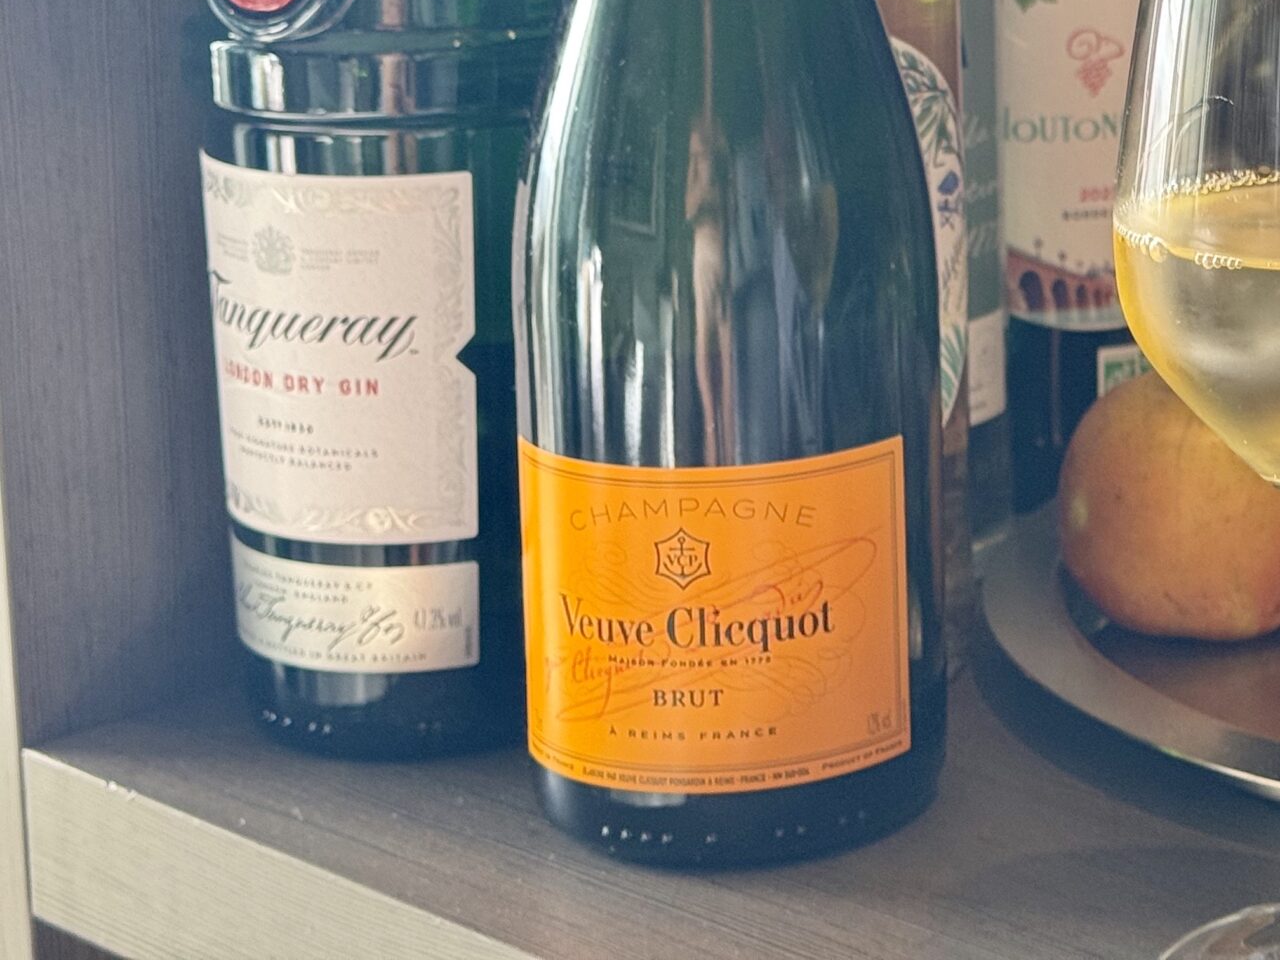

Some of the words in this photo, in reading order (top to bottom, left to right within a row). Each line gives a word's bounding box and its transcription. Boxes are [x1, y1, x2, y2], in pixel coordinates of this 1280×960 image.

[223, 360, 274, 388] LONDON
[283, 375, 325, 396] DRY
[338, 379, 380, 396] GIN
[569, 497, 817, 531] CHAMPAGNE
[559, 592, 654, 648] Veuve
[666, 600, 835, 652] Clicquot
[652, 689, 725, 707] BRUT
[628, 729, 686, 741] REIMS
[700, 726, 778, 741] FRANCE
